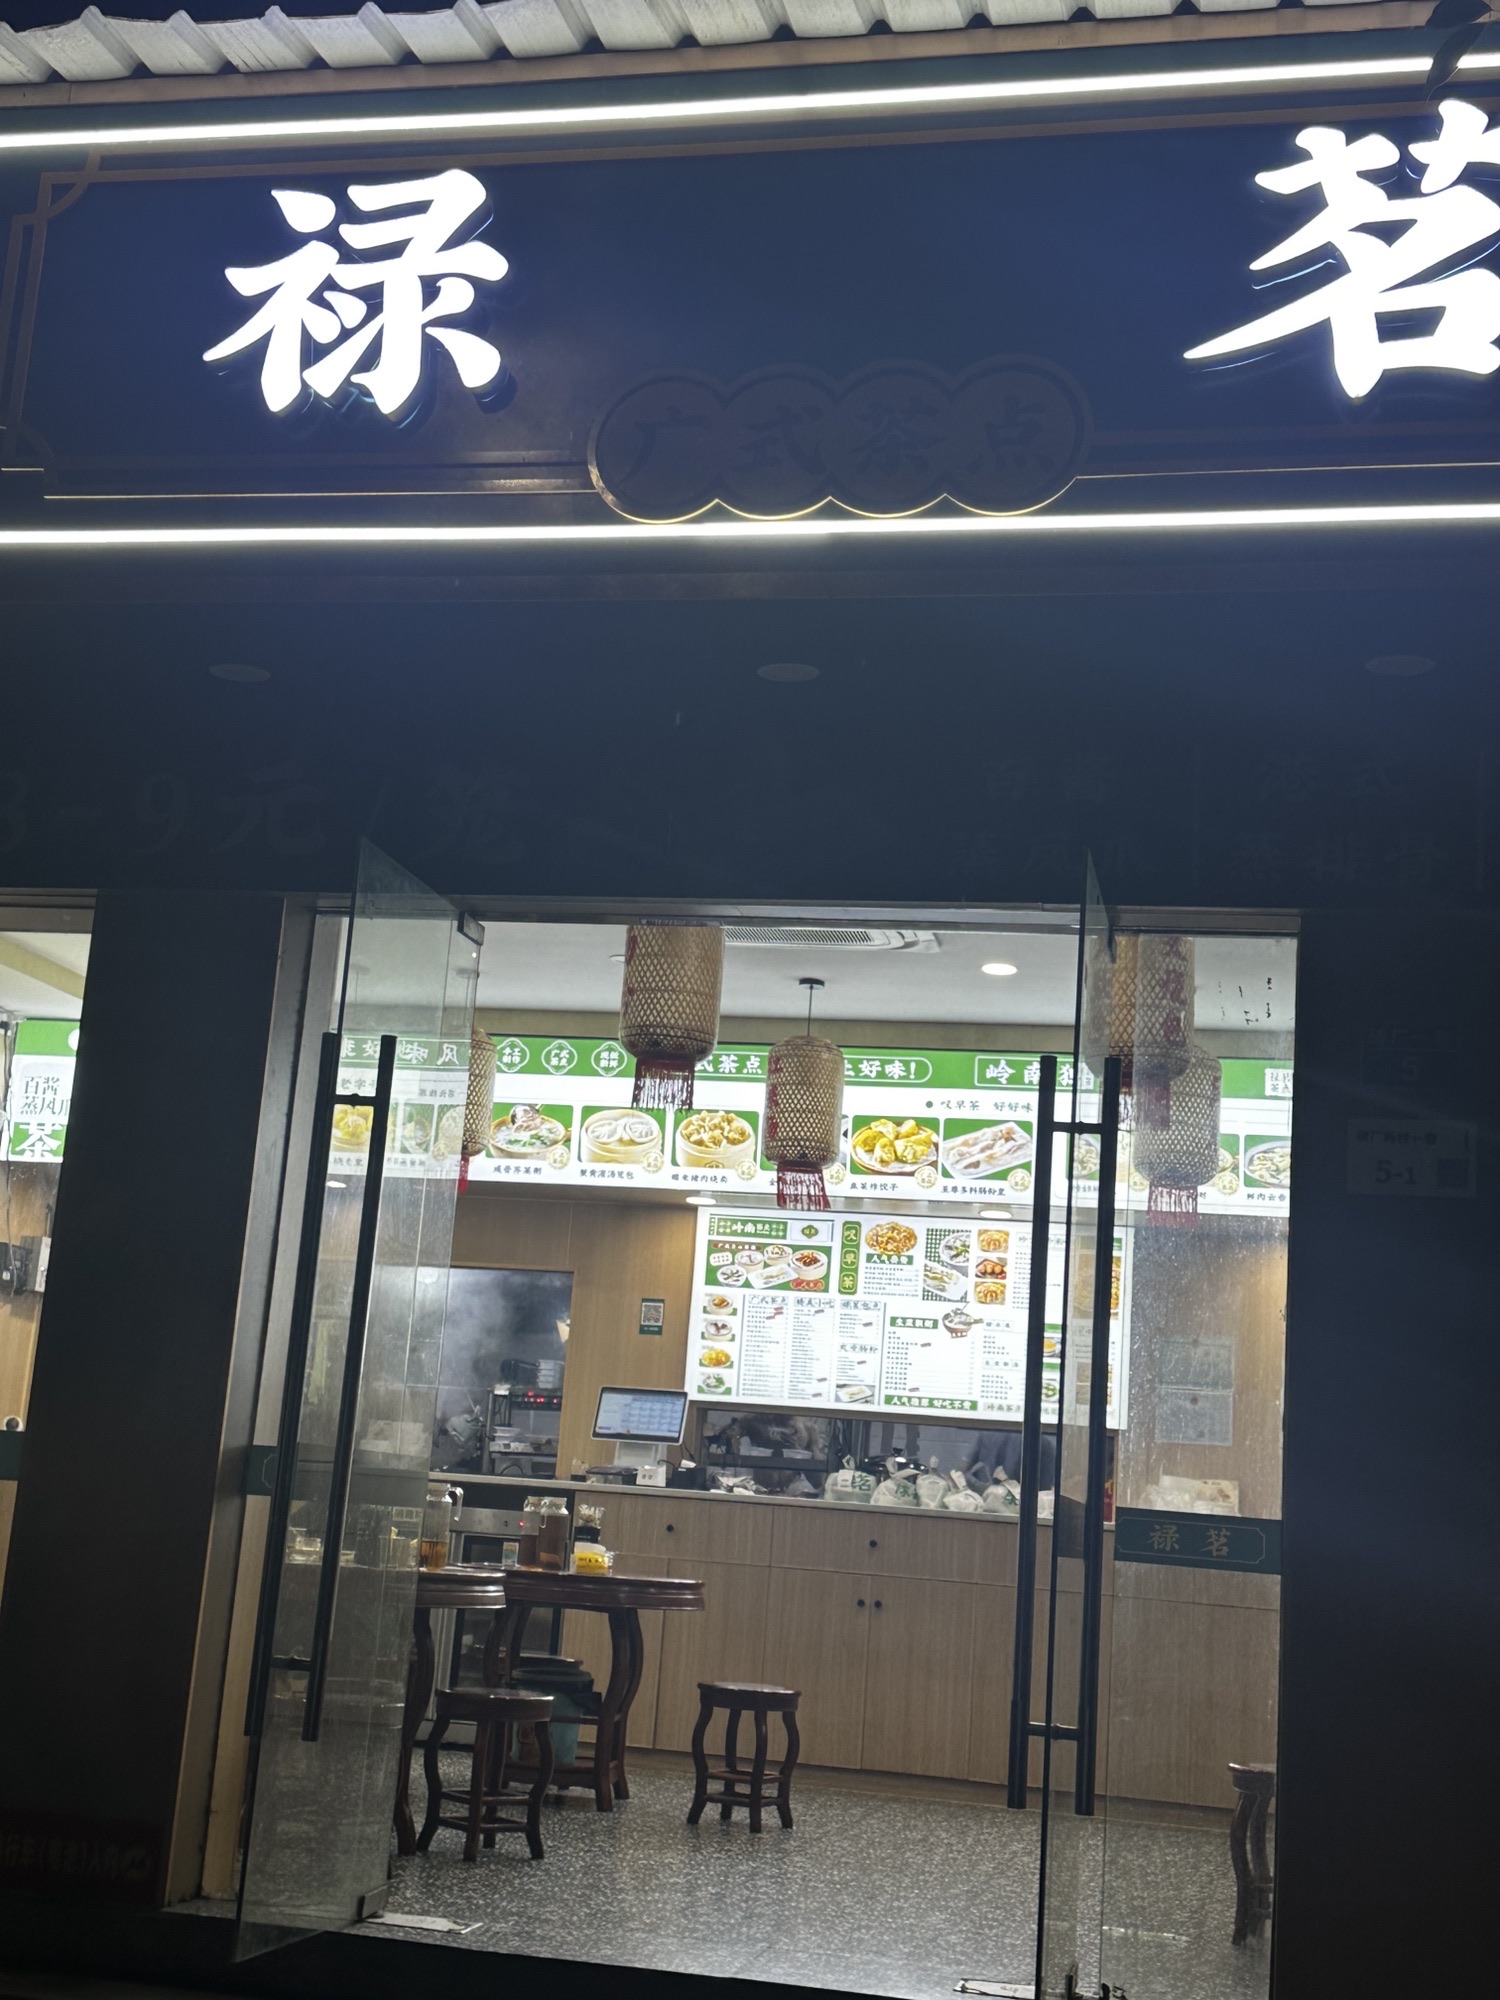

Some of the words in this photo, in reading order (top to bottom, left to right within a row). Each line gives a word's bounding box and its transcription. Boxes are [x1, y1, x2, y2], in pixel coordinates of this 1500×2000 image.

[203, 168, 509, 415] 禄
[1183, 98, 1500, 399] 茗
[618, 395, 1056, 485] 广式茶点
[24, 1075, 60, 1095] 百酱
[15, 1121, 63, 1158] 茶
[1375, 1159, 1416, 1185] 5-1
[1147, 1523, 1232, 1558] 禄茗
